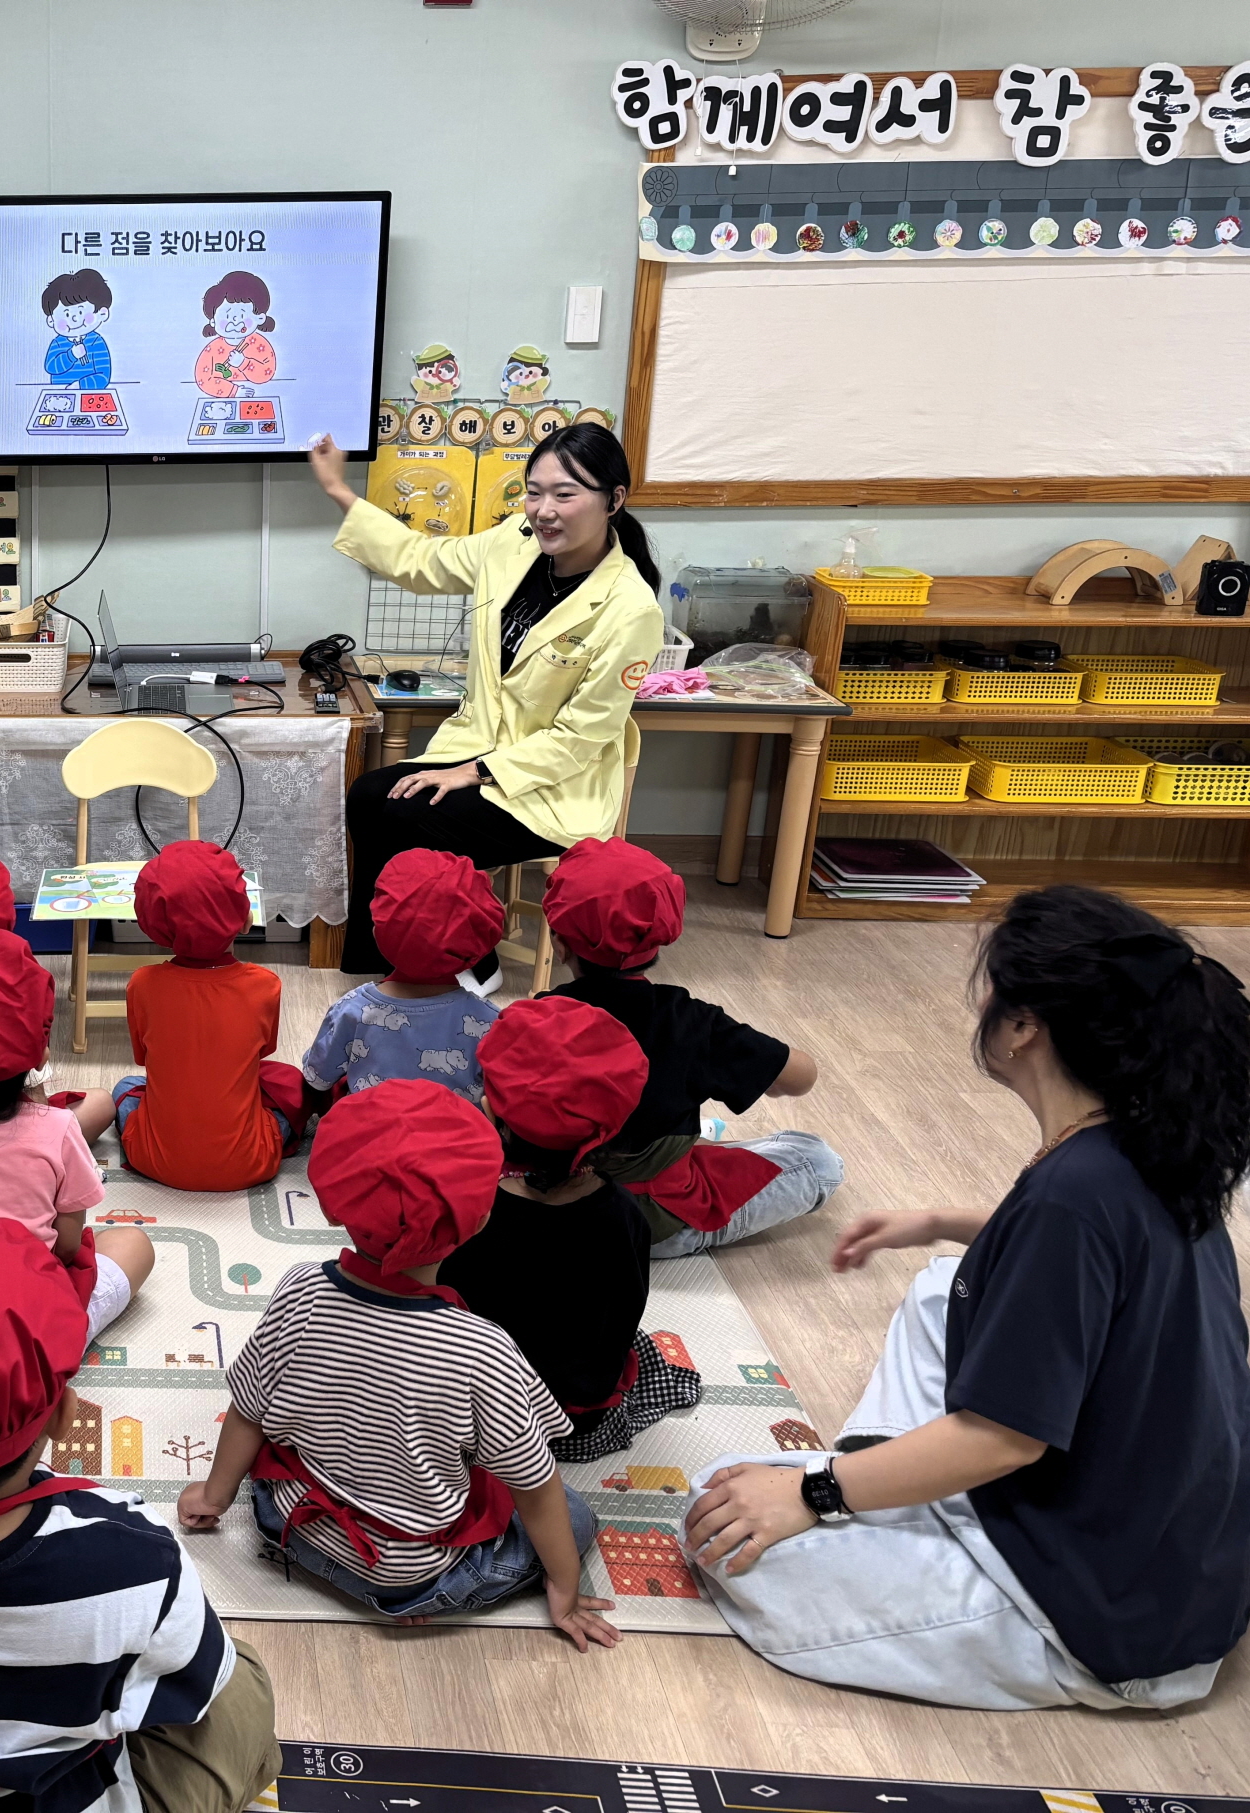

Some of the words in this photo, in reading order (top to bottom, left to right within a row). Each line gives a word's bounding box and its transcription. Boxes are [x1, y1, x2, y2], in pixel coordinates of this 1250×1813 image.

[618, 65, 951, 146] 함께여서
[1004, 70, 1085, 157] 참
[61, 232, 103, 256] 다른
[110, 231, 152, 256] 점을
[160, 230, 267, 256] 찾아보아요
[378, 413, 558, 436] 관찰해보아
[314, 1748, 326, 1776] 보호구역
[339, 1755, 355, 1771] 30
